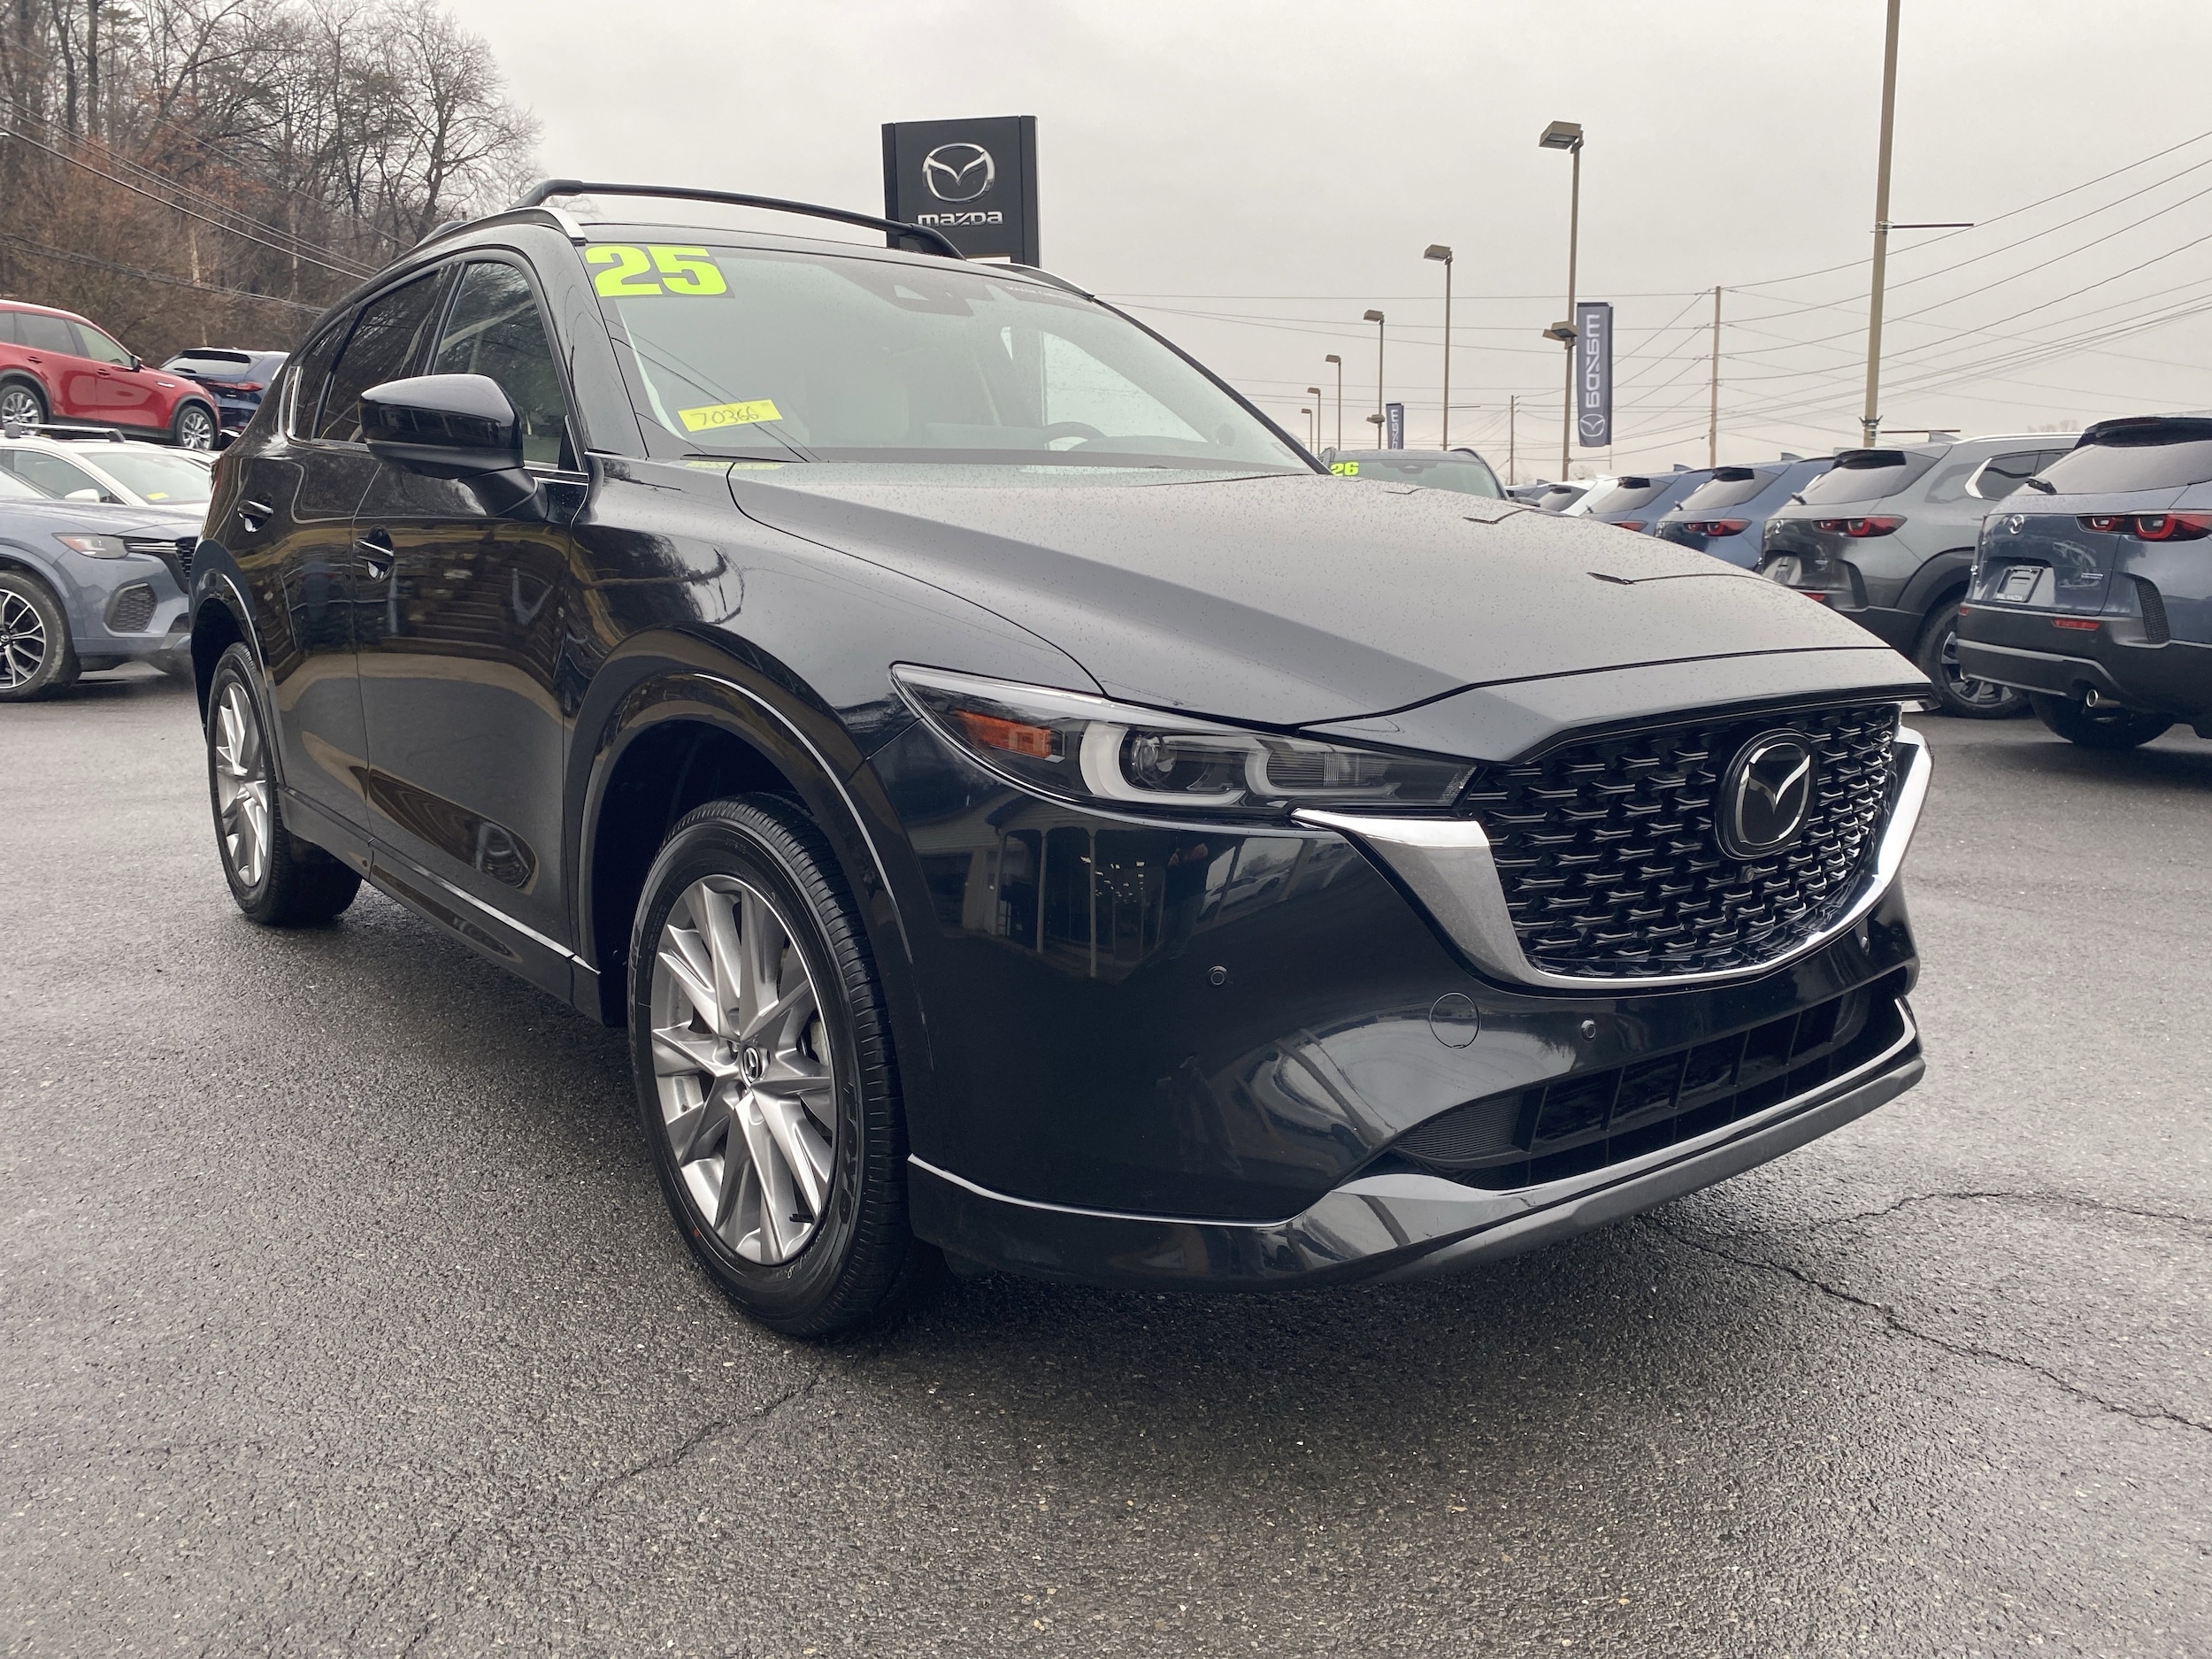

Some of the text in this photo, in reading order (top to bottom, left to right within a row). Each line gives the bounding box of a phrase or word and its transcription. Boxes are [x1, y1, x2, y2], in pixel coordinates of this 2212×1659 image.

[918, 211, 1003, 227] mazda
[585, 245, 727, 297] 25
[689, 406, 759, 426] 70366
[1330, 462, 1359, 476] 26
